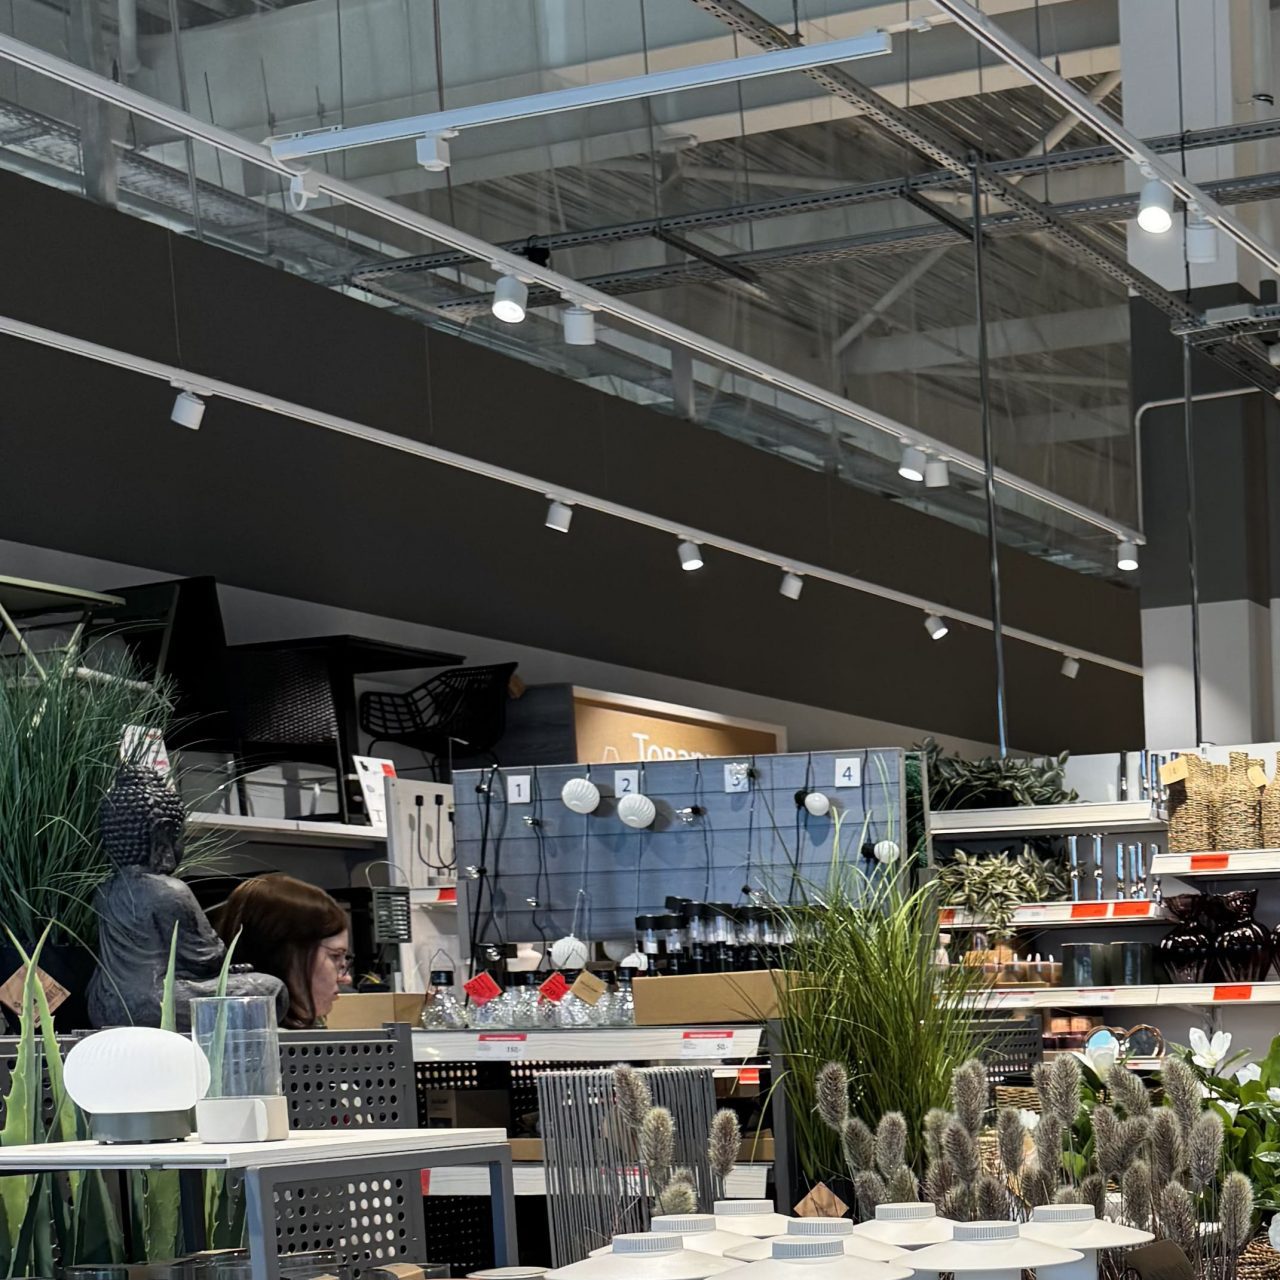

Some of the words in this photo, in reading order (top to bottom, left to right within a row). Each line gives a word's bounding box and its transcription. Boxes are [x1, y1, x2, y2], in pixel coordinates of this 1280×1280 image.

[632, 732, 714, 761] Това
[842, 766, 853, 781] 4
[515, 783, 521, 798] 1
[621, 778, 631, 792] 2
